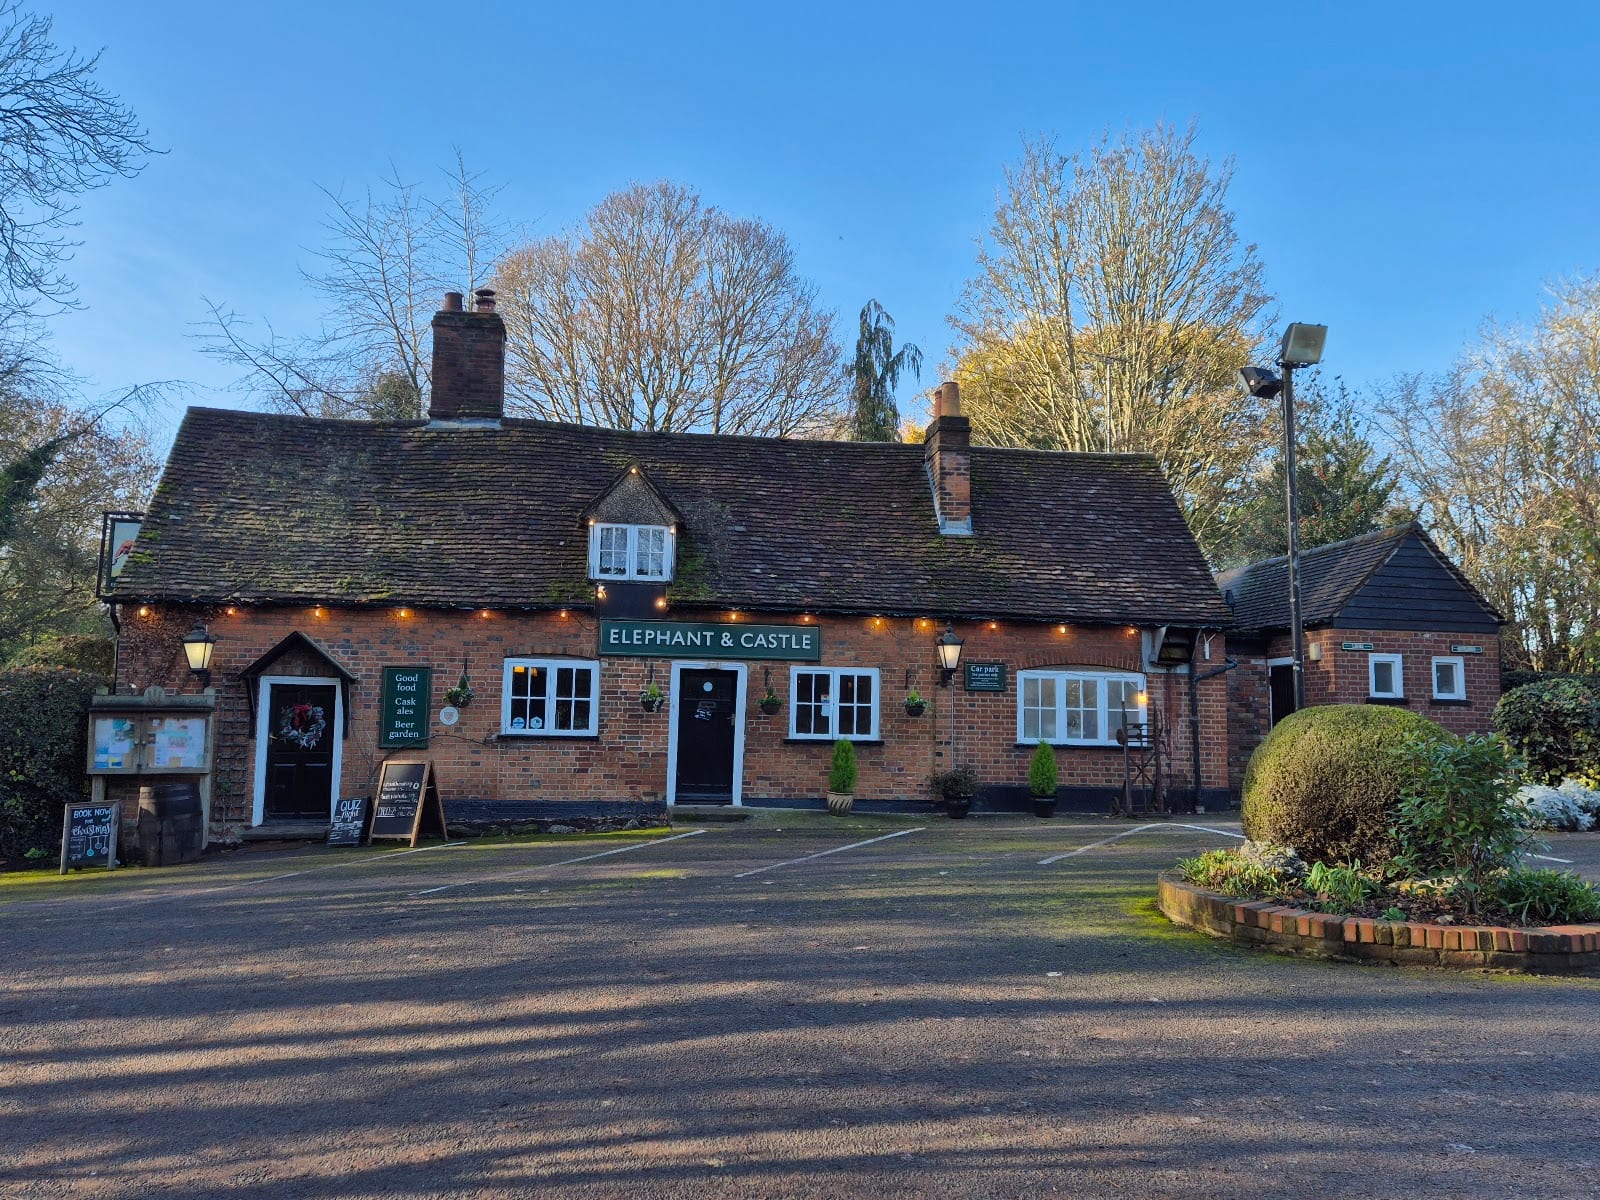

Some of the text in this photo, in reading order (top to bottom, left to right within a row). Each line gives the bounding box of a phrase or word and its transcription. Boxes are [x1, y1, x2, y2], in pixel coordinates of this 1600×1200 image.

[609, 628, 812, 650] ELEPHANT & CASTLE
[984, 665, 999, 674] park
[395, 673, 418, 682] Good
[397, 683, 416, 692] food
[395, 697, 416, 706] Cask
[396, 706, 414, 715] ales
[395, 720, 415, 729] Beer
[388, 730, 419, 740] garden
[340, 799, 362, 812] QUIZ
[73, 807, 112, 819] BOOK NOW
[341, 809, 359, 822] night
